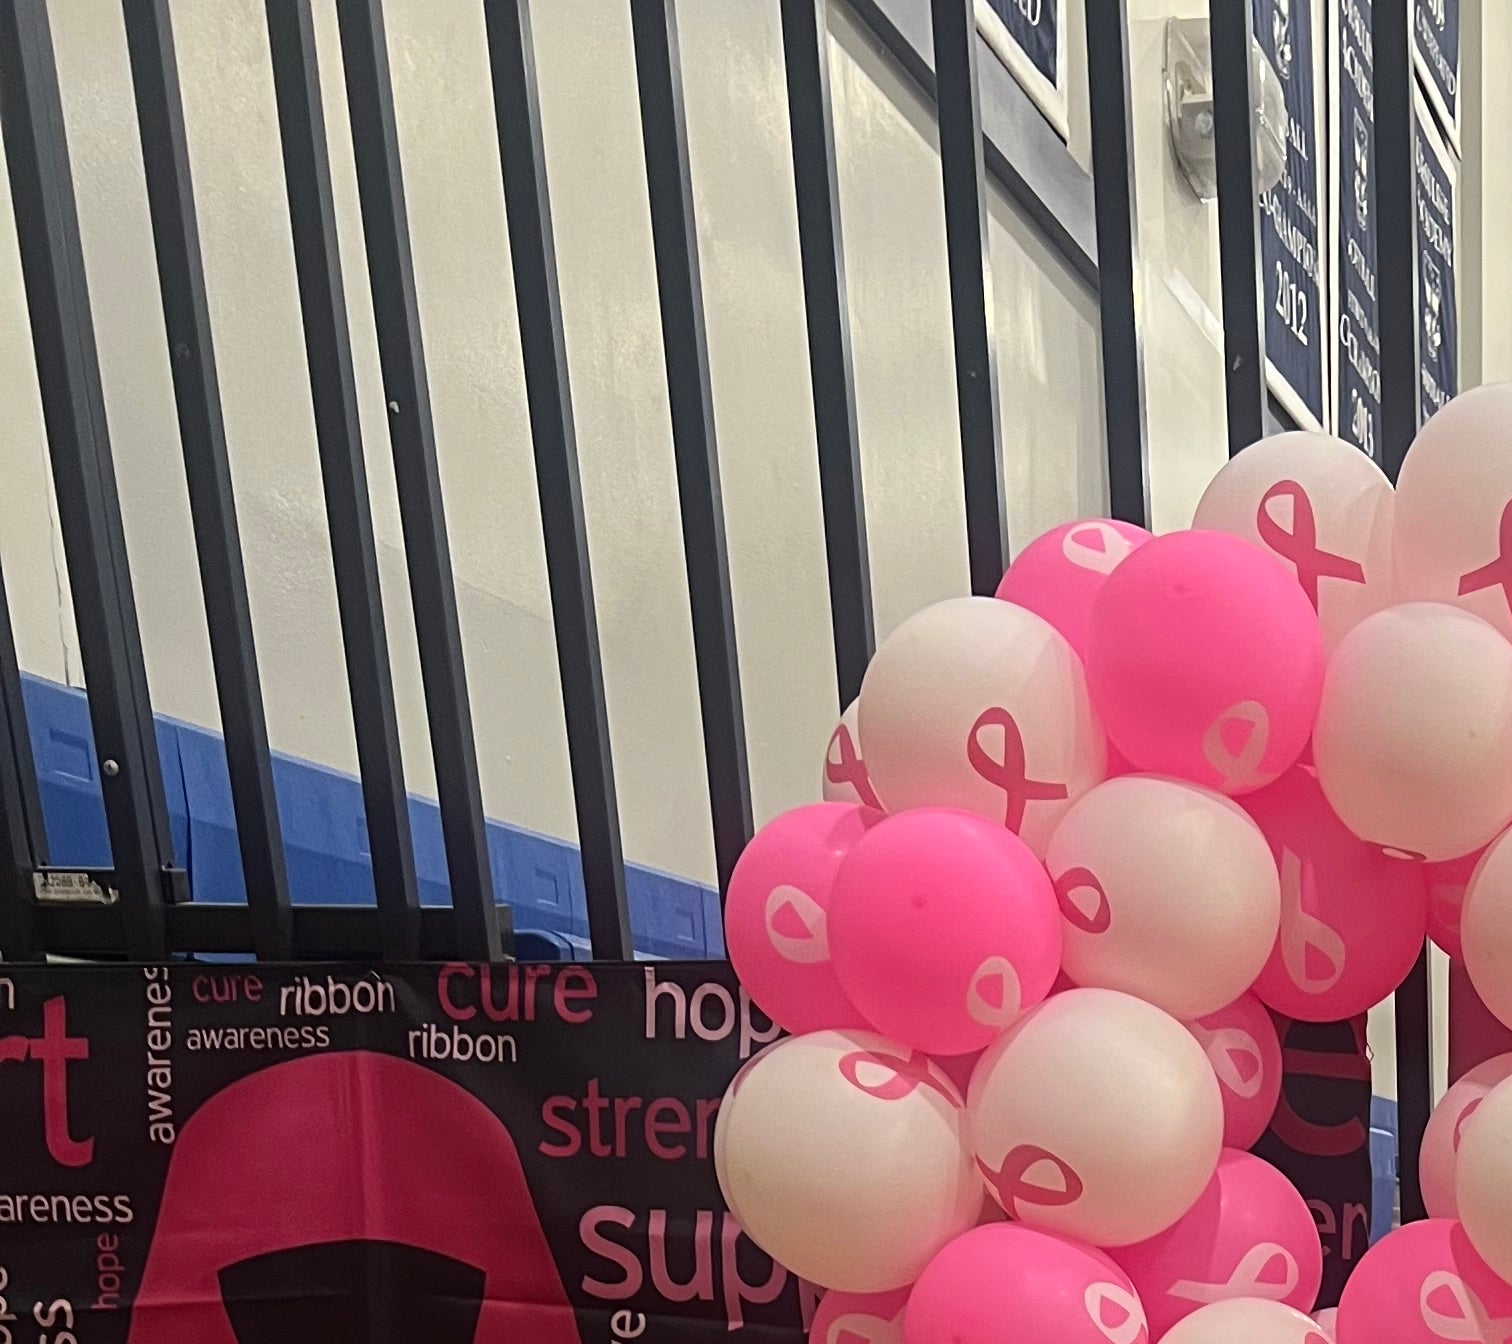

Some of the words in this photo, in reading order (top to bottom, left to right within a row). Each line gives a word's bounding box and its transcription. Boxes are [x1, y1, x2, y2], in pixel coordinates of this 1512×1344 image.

[1275, 260, 1308, 346] 2012
[192, 973, 264, 1002] cure
[279, 975, 396, 1016] ribbon
[437, 964, 599, 1023] cure
[644, 967, 783, 1058] hop
[187, 1025, 331, 1051] awareness
[408, 1024, 518, 1063] ribbon
[0, 1194, 134, 1224] areness
[92, 1232, 125, 1309] hope
